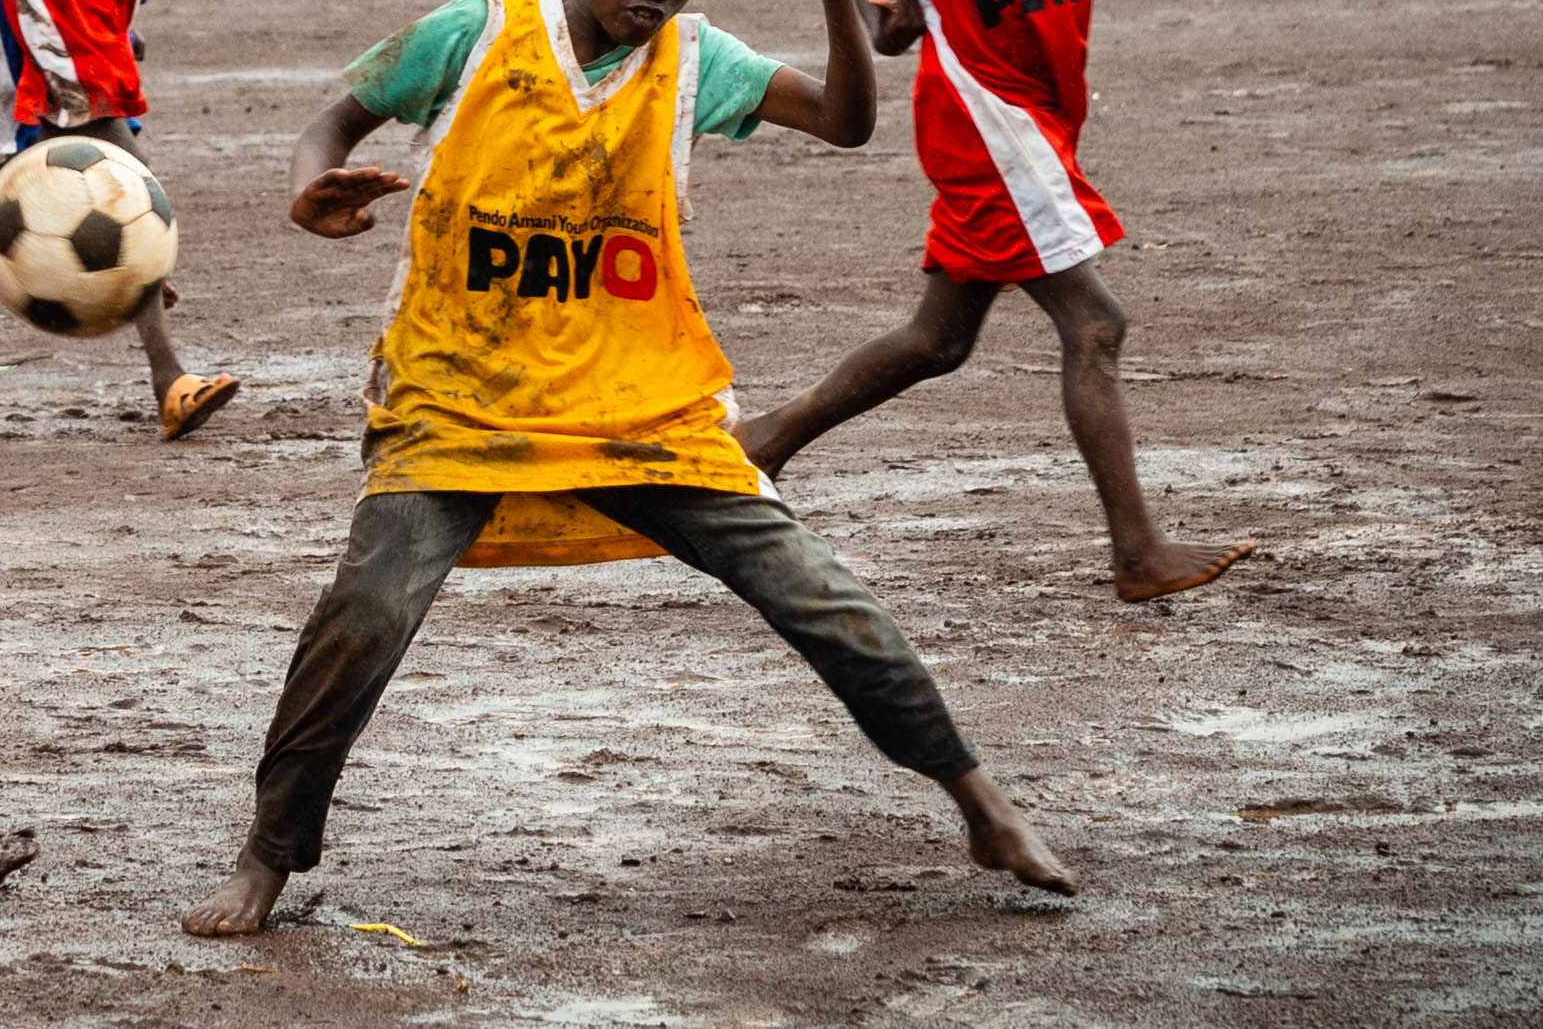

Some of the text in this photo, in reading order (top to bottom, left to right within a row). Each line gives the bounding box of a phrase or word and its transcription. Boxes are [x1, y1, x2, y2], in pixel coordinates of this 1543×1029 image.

[468, 205, 507, 227] Pendo
[508, 212, 556, 230] Amani
[466, 226, 657, 303] PAYO
